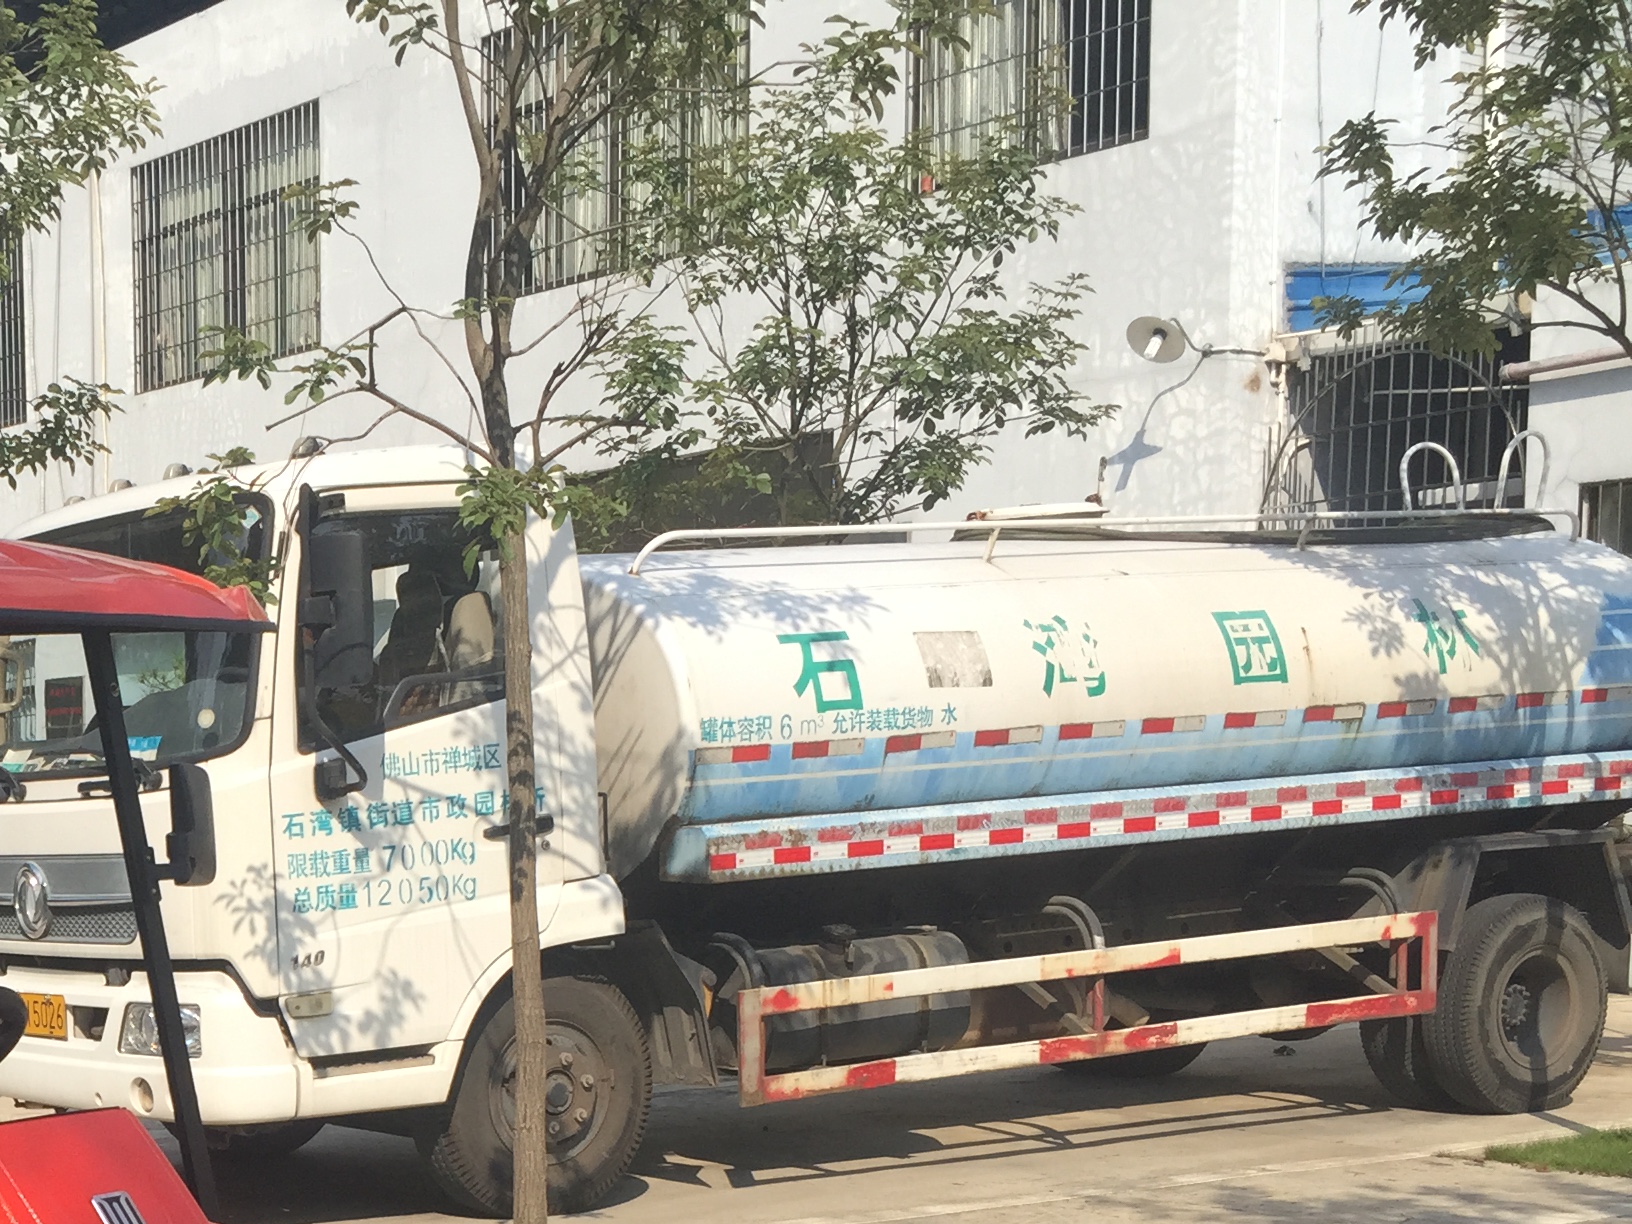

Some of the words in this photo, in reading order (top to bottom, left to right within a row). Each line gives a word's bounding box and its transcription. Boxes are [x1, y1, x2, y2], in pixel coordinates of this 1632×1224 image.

[776, 630, 863, 713] 石
[1210, 609, 1289, 686] 园
[699, 714, 773, 744] 罐体容积
[780, 713, 793, 740] 6
[831, 704, 935, 735] 允许装载货物
[940, 702, 958, 725] 水
[380, 742, 502, 780] 佛山市禅城区
[287, 846, 372, 880] 限载重量
[289, 949, 325, 971] 140
[26, 1000, 63, 1030] 5026
